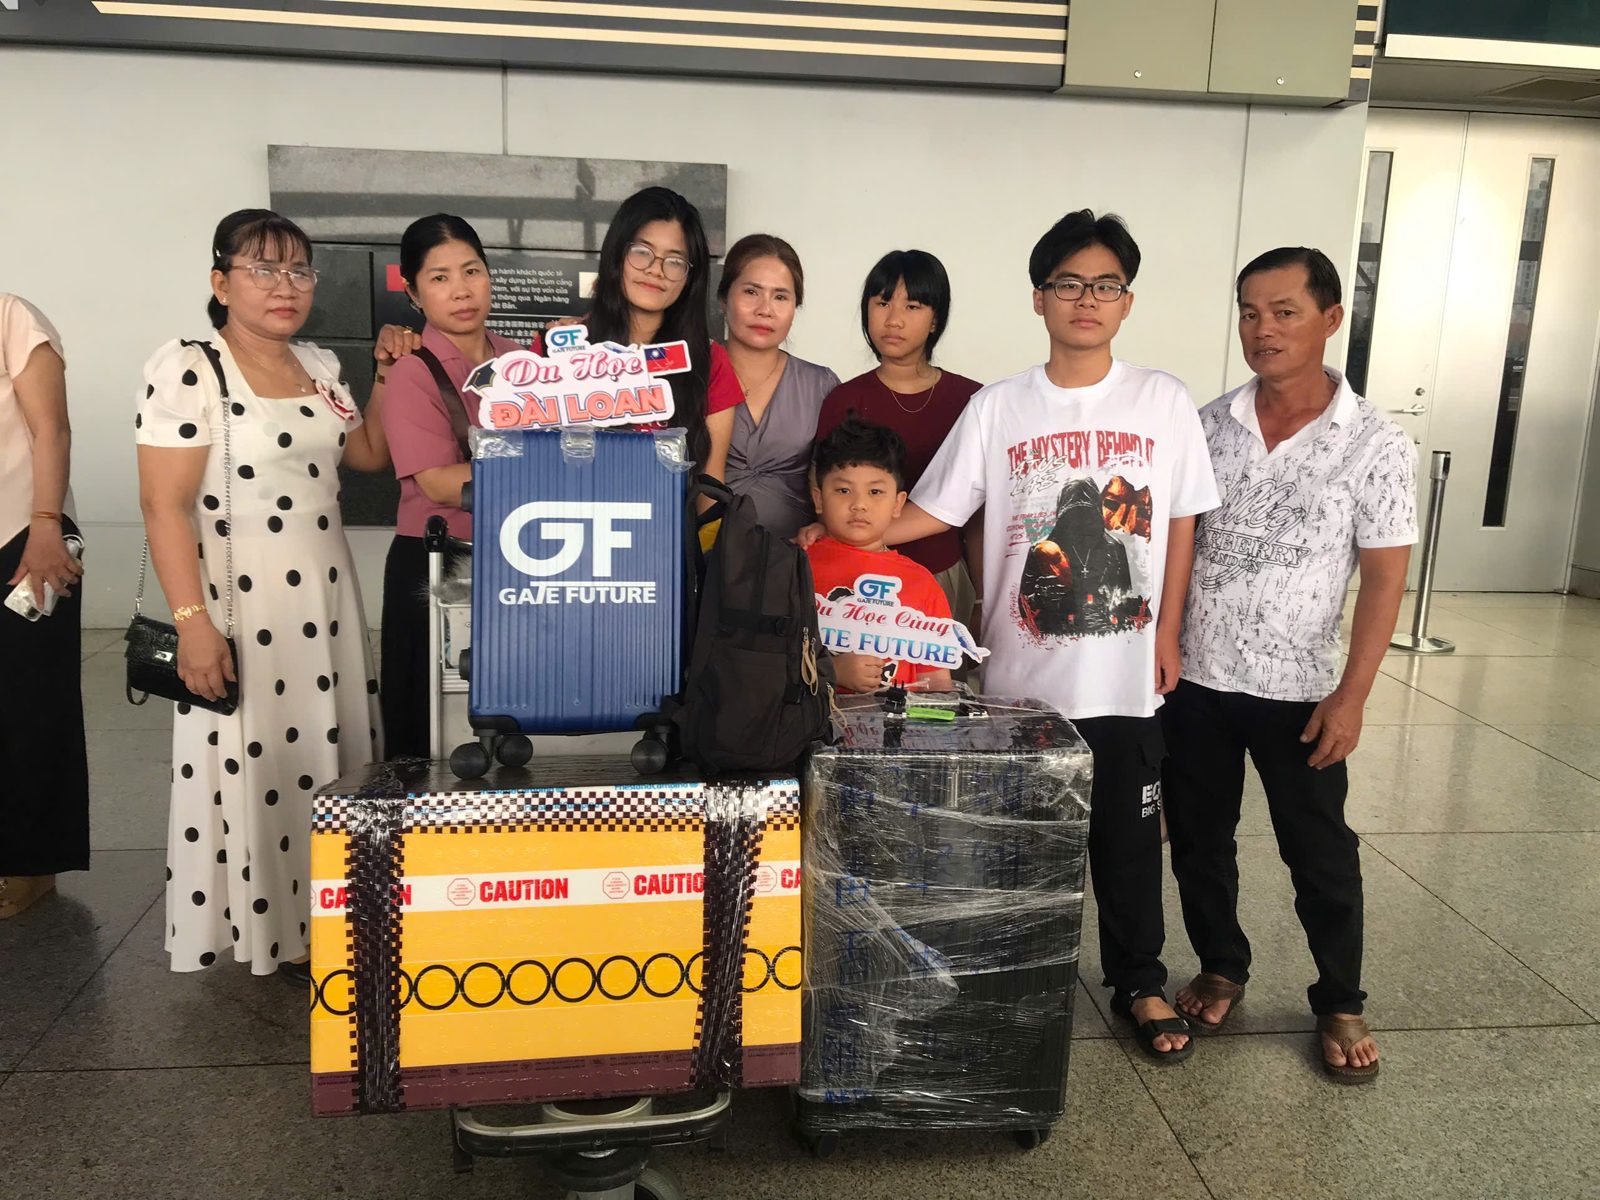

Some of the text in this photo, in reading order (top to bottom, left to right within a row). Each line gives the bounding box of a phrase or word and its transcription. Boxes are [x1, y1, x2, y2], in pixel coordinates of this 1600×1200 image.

[551, 329, 582, 347] GF
[502, 353, 643, 386] Du Học
[490, 385, 666, 429] ĐÀI LOAN
[1032, 430, 1091, 469] MYSTERY
[1096, 430, 1143, 468] BEHIND
[499, 501, 652, 577] GF
[499, 581, 656, 605] GATE FUTURE
[858, 579, 896, 599] GF
[842, 603, 887, 626] Học
[895, 609, 950, 637] Cùng
[858, 632, 957, 665] FUTURE
[1142, 804, 1155, 818] BIG
[480, 878, 568, 901] CAUTION
[634, 872, 704, 895] CAUTIO
